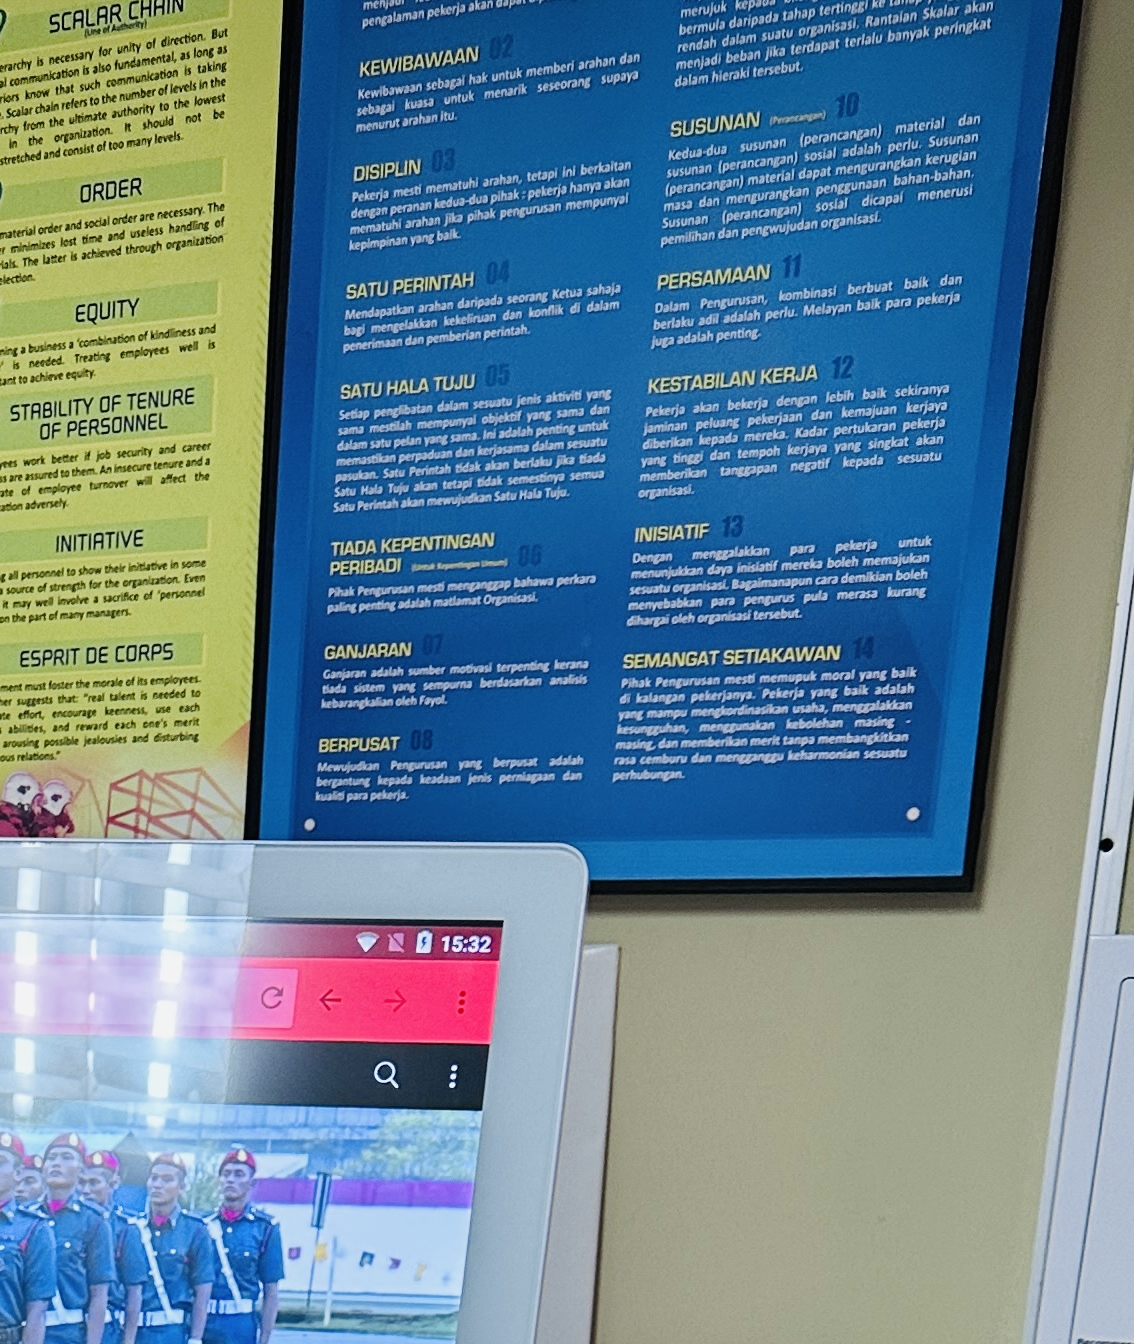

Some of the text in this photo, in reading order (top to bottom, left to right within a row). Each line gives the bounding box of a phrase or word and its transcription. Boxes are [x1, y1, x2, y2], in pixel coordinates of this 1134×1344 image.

[49, 2, 122, 33] SCALAR
[128, 0, 184, 21] CHAIN
[37, 57, 43, 67] is
[49, 50, 94, 65] necessary
[98, 47, 112, 57] for
[118, 42, 141, 55] unity
[146, 39, 156, 50] of
[161, 32, 206, 48] direction.
[212, 28, 228, 39] But
[359, 34, 514, 77] KEWIBAWAAN 02
[670, 112, 760, 138] SUSUNAN
[835, 92, 859, 118] 10
[353, 148, 455, 182] DISIPLIN 03
[80, 178, 142, 203] ORDER
[346, 260, 510, 299] SATU PERINTAH 04
[657, 253, 802, 290] PERSAMAAN 11
[75, 298, 140, 324] EQUITY
[340, 363, 509, 399] SATU HALA TUJU 05
[648, 355, 854, 394] KESTABILAN KERJA 12
[10, 388, 195, 422] STABILITY OF TENURE
[40, 422, 61, 440] OF
[67, 413, 168, 438] PERSONNEL
[56, 529, 144, 552] INITIATIVE
[635, 515, 744, 543] INISIATIF 13
[332, 532, 495, 556] TIADA KEPENTINGAN
[330, 558, 402, 576] PERIBADI
[20, 648, 80, 668] ESPRIT
[86, 646, 108, 664] DE
[116, 642, 174, 663] CORPS
[324, 643, 412, 660] GANJARAN
[623, 651, 719, 669] SEMANGAT
[723, 645, 841, 665] SETIAKAWAN
[319, 736, 400, 753] BERPUSAT
[442, 936, 492, 953] 15:32
